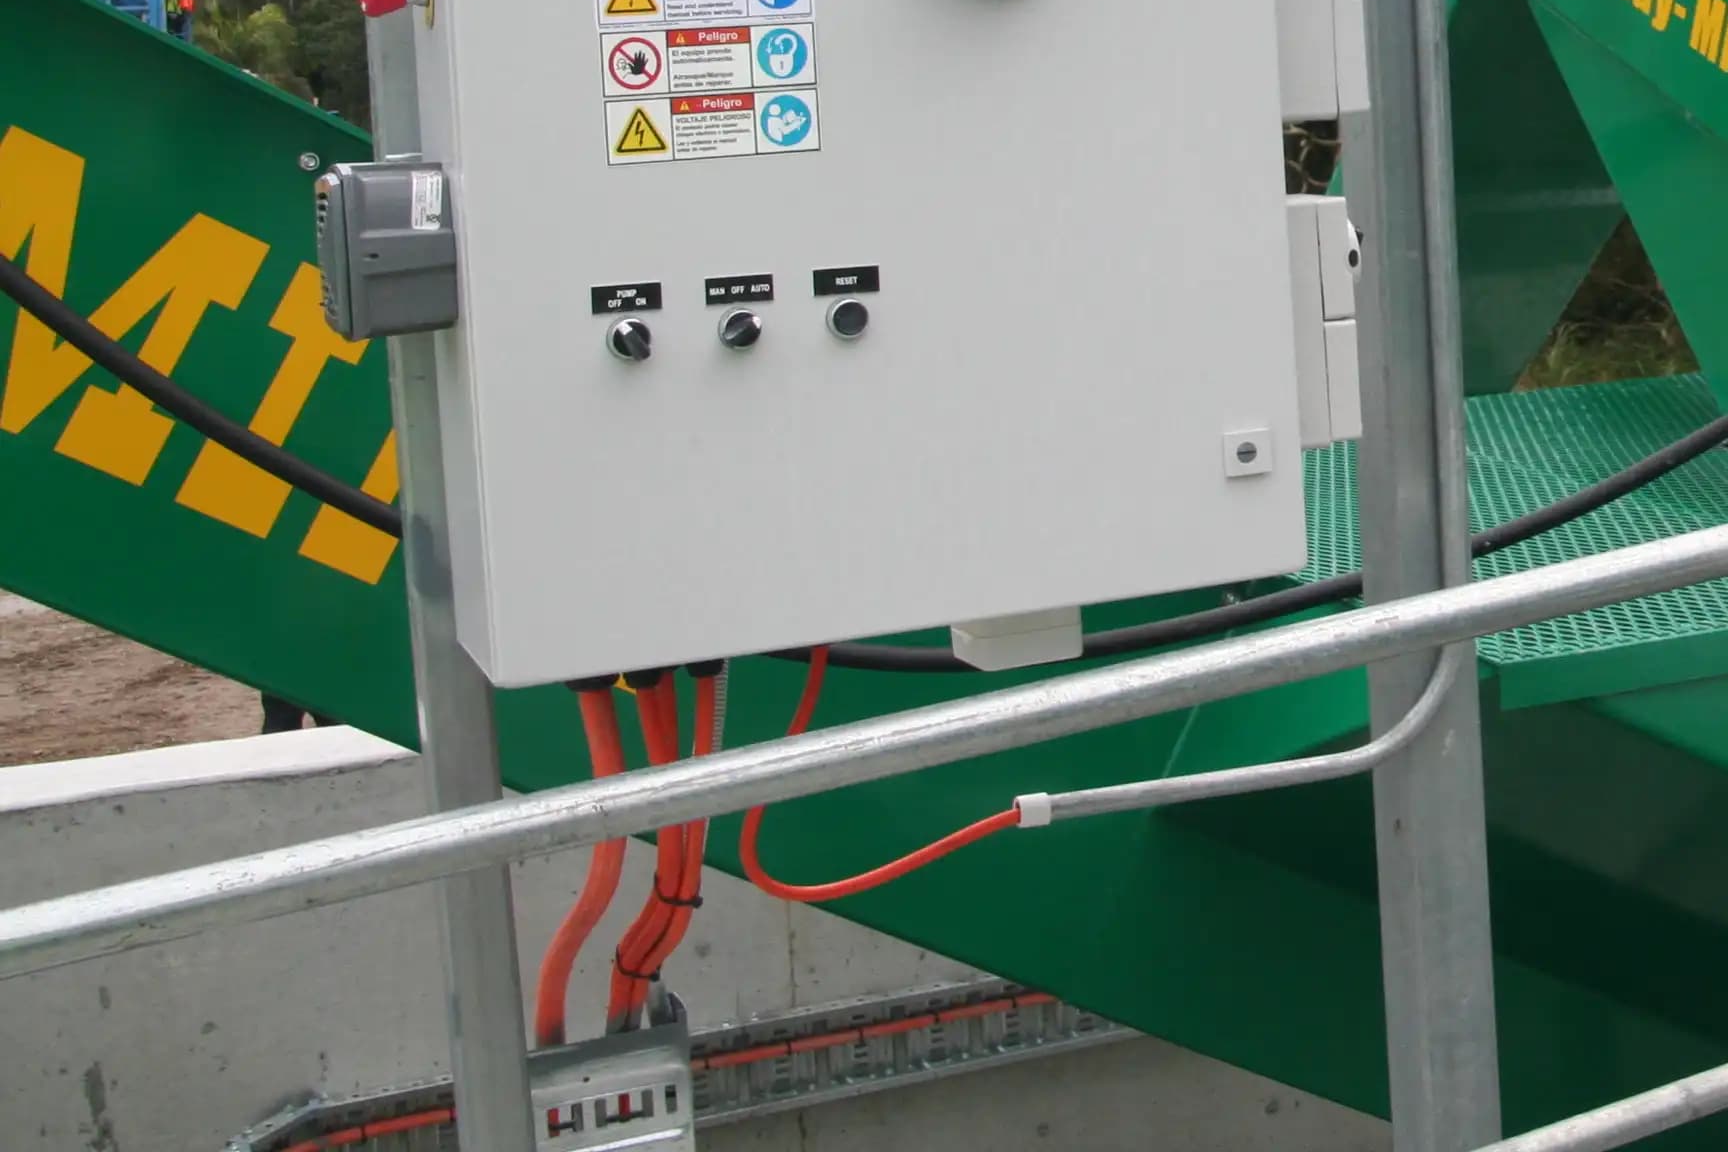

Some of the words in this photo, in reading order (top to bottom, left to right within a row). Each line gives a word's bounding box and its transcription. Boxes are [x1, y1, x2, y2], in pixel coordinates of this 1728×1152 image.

[698, 32, 738, 42] Peligro
[702, 99, 742, 109] Peligro
[835, 276, 858, 285] RESET
[616, 289, 637, 298] PUMP
[709, 287, 725, 296] MAN
[731, 285, 745, 294] OFF
[751, 284, 770, 293] AUTO
[608, 300, 622, 308] OFF
[635, 298, 646, 306] ON
